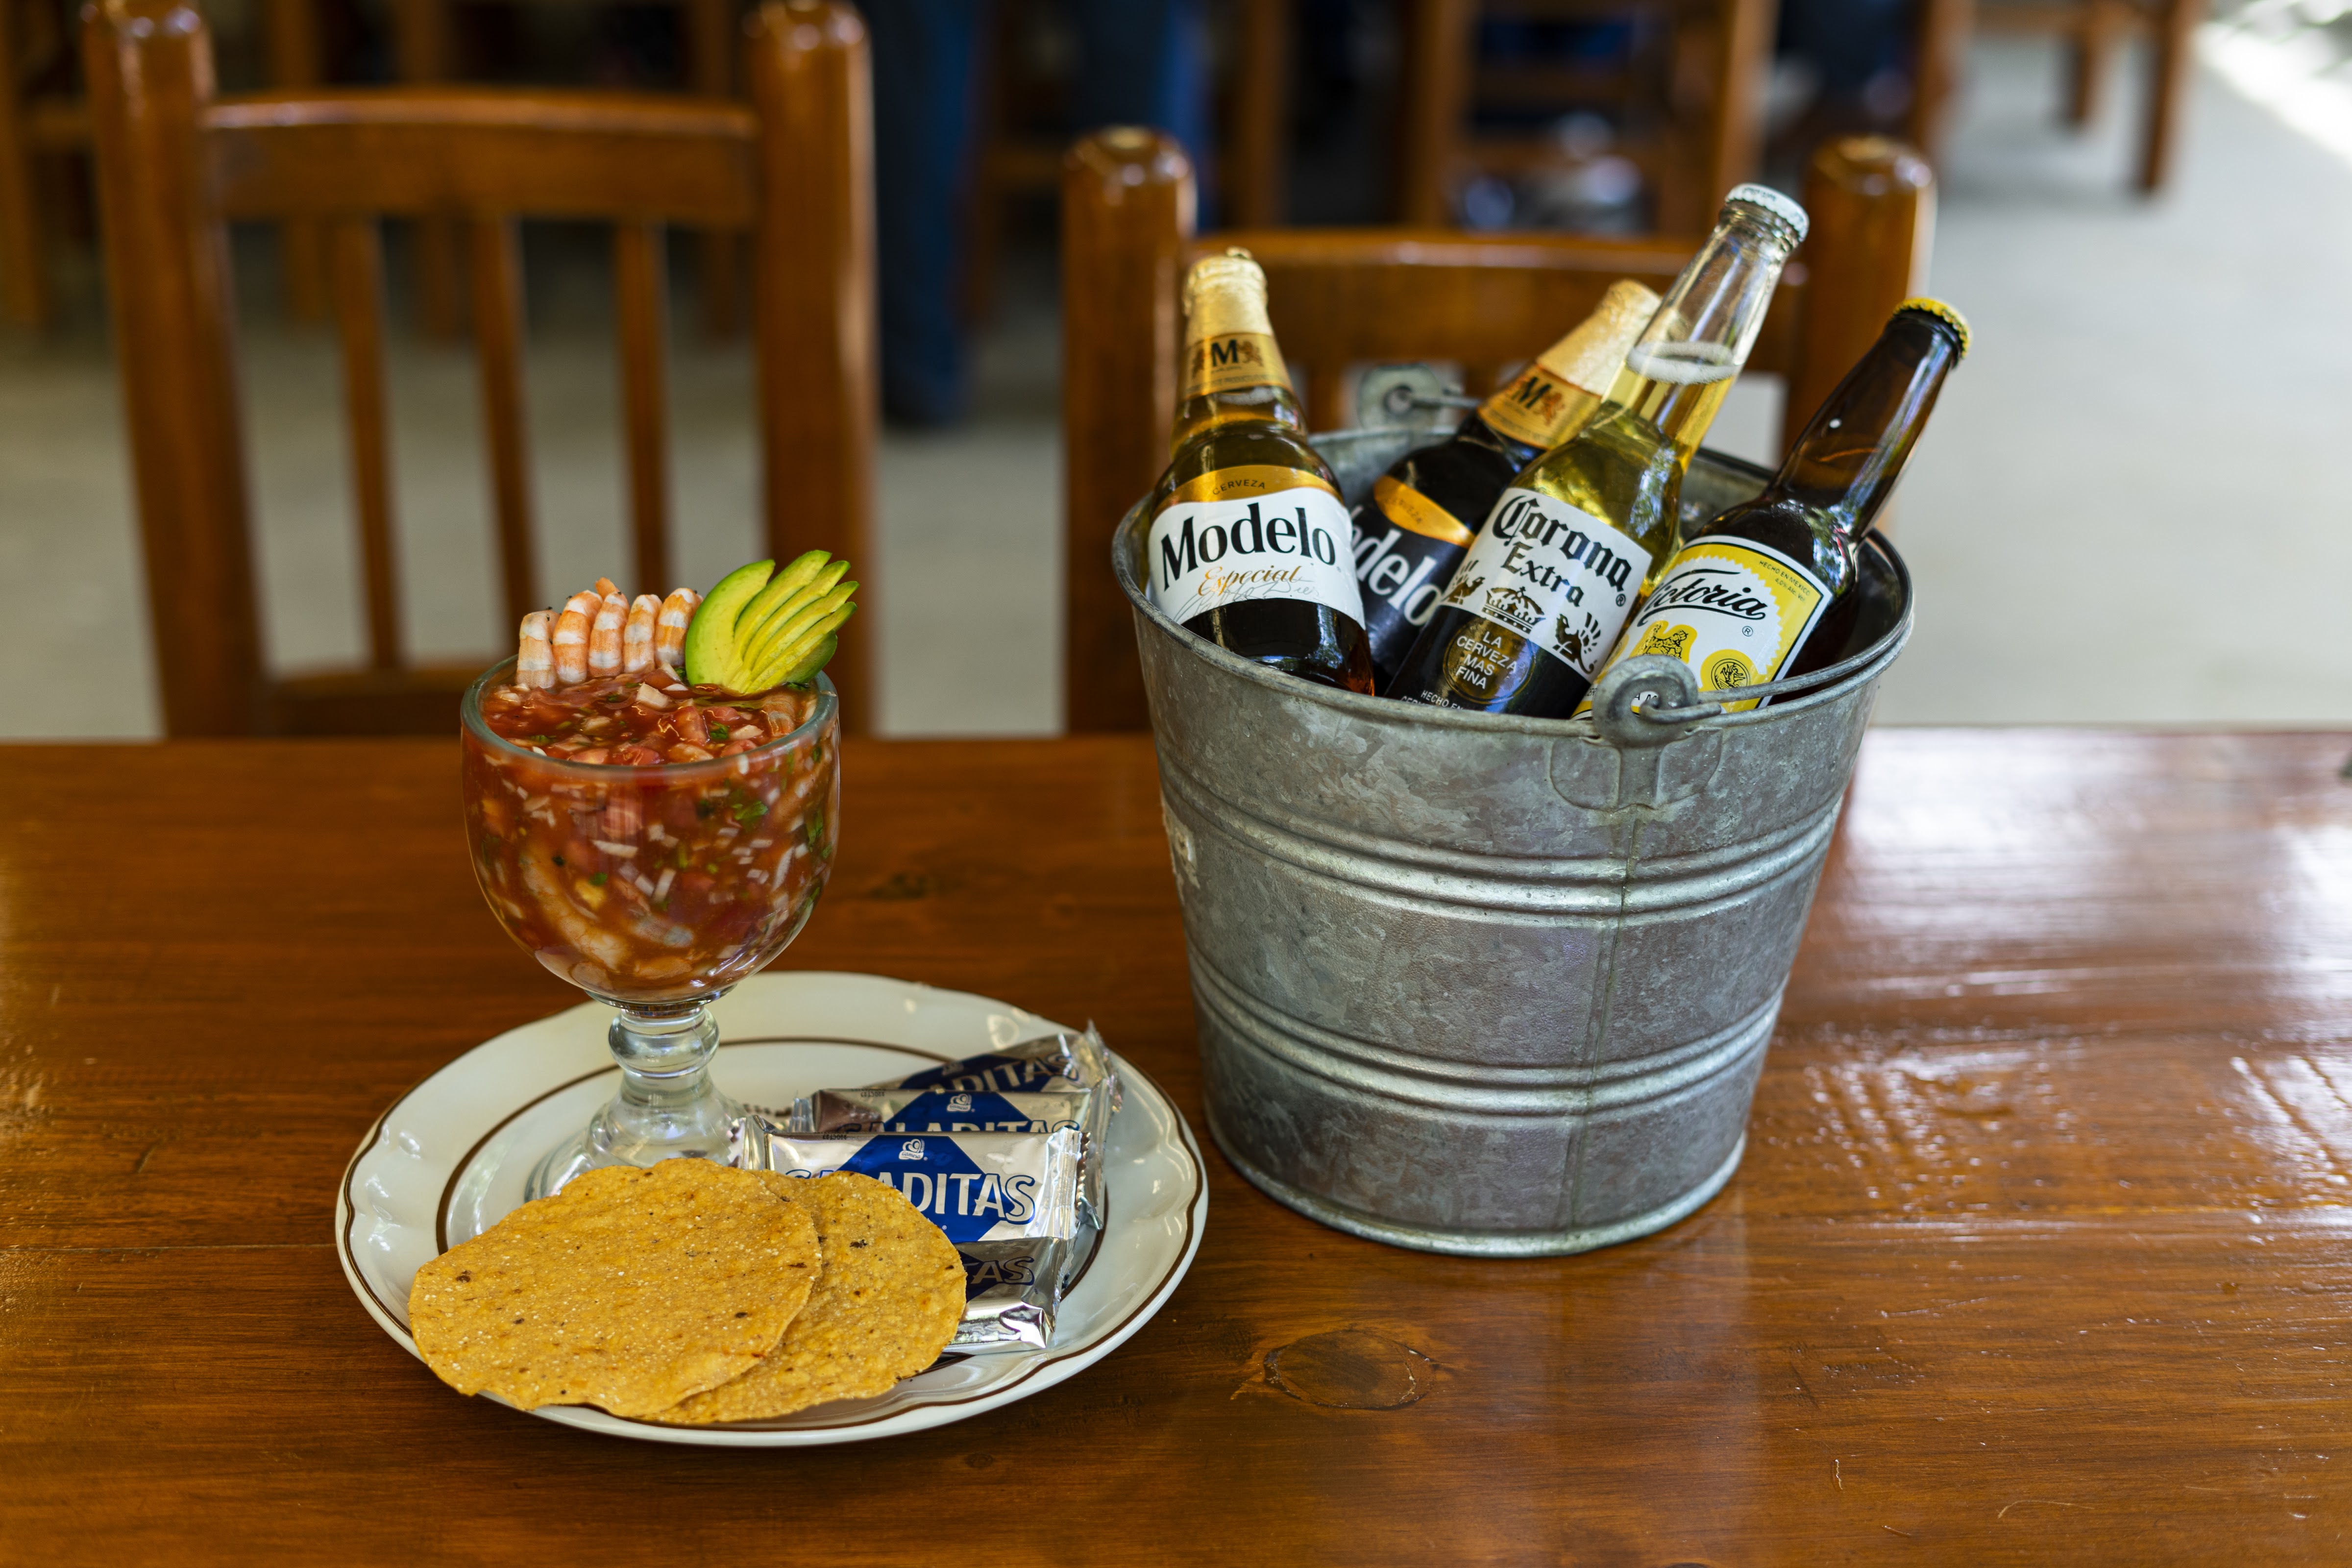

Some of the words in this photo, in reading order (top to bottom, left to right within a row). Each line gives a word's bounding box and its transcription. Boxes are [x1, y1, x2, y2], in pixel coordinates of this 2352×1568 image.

[1211, 340, 1239, 367] M
[1212, 479, 1265, 495] CERVEZA
[1161, 502, 1335, 592] Modelo
[1492, 495, 1632, 592] Corona
[1198, 564, 1303, 596] Especial
[1350, 504, 1443, 626] delo
[1500, 540, 1584, 607] Extra
[1759, 561, 1780, 574] HECHO
[1789, 577, 1811, 596] MEXICO
[1456, 636, 1518, 674] CERVEZA
[1482, 631, 1502, 648] LA
[1455, 665, 1487, 690] FINA
[1463, 654, 1495, 676] MAS
[1421, 689, 1449, 707] HECHO
